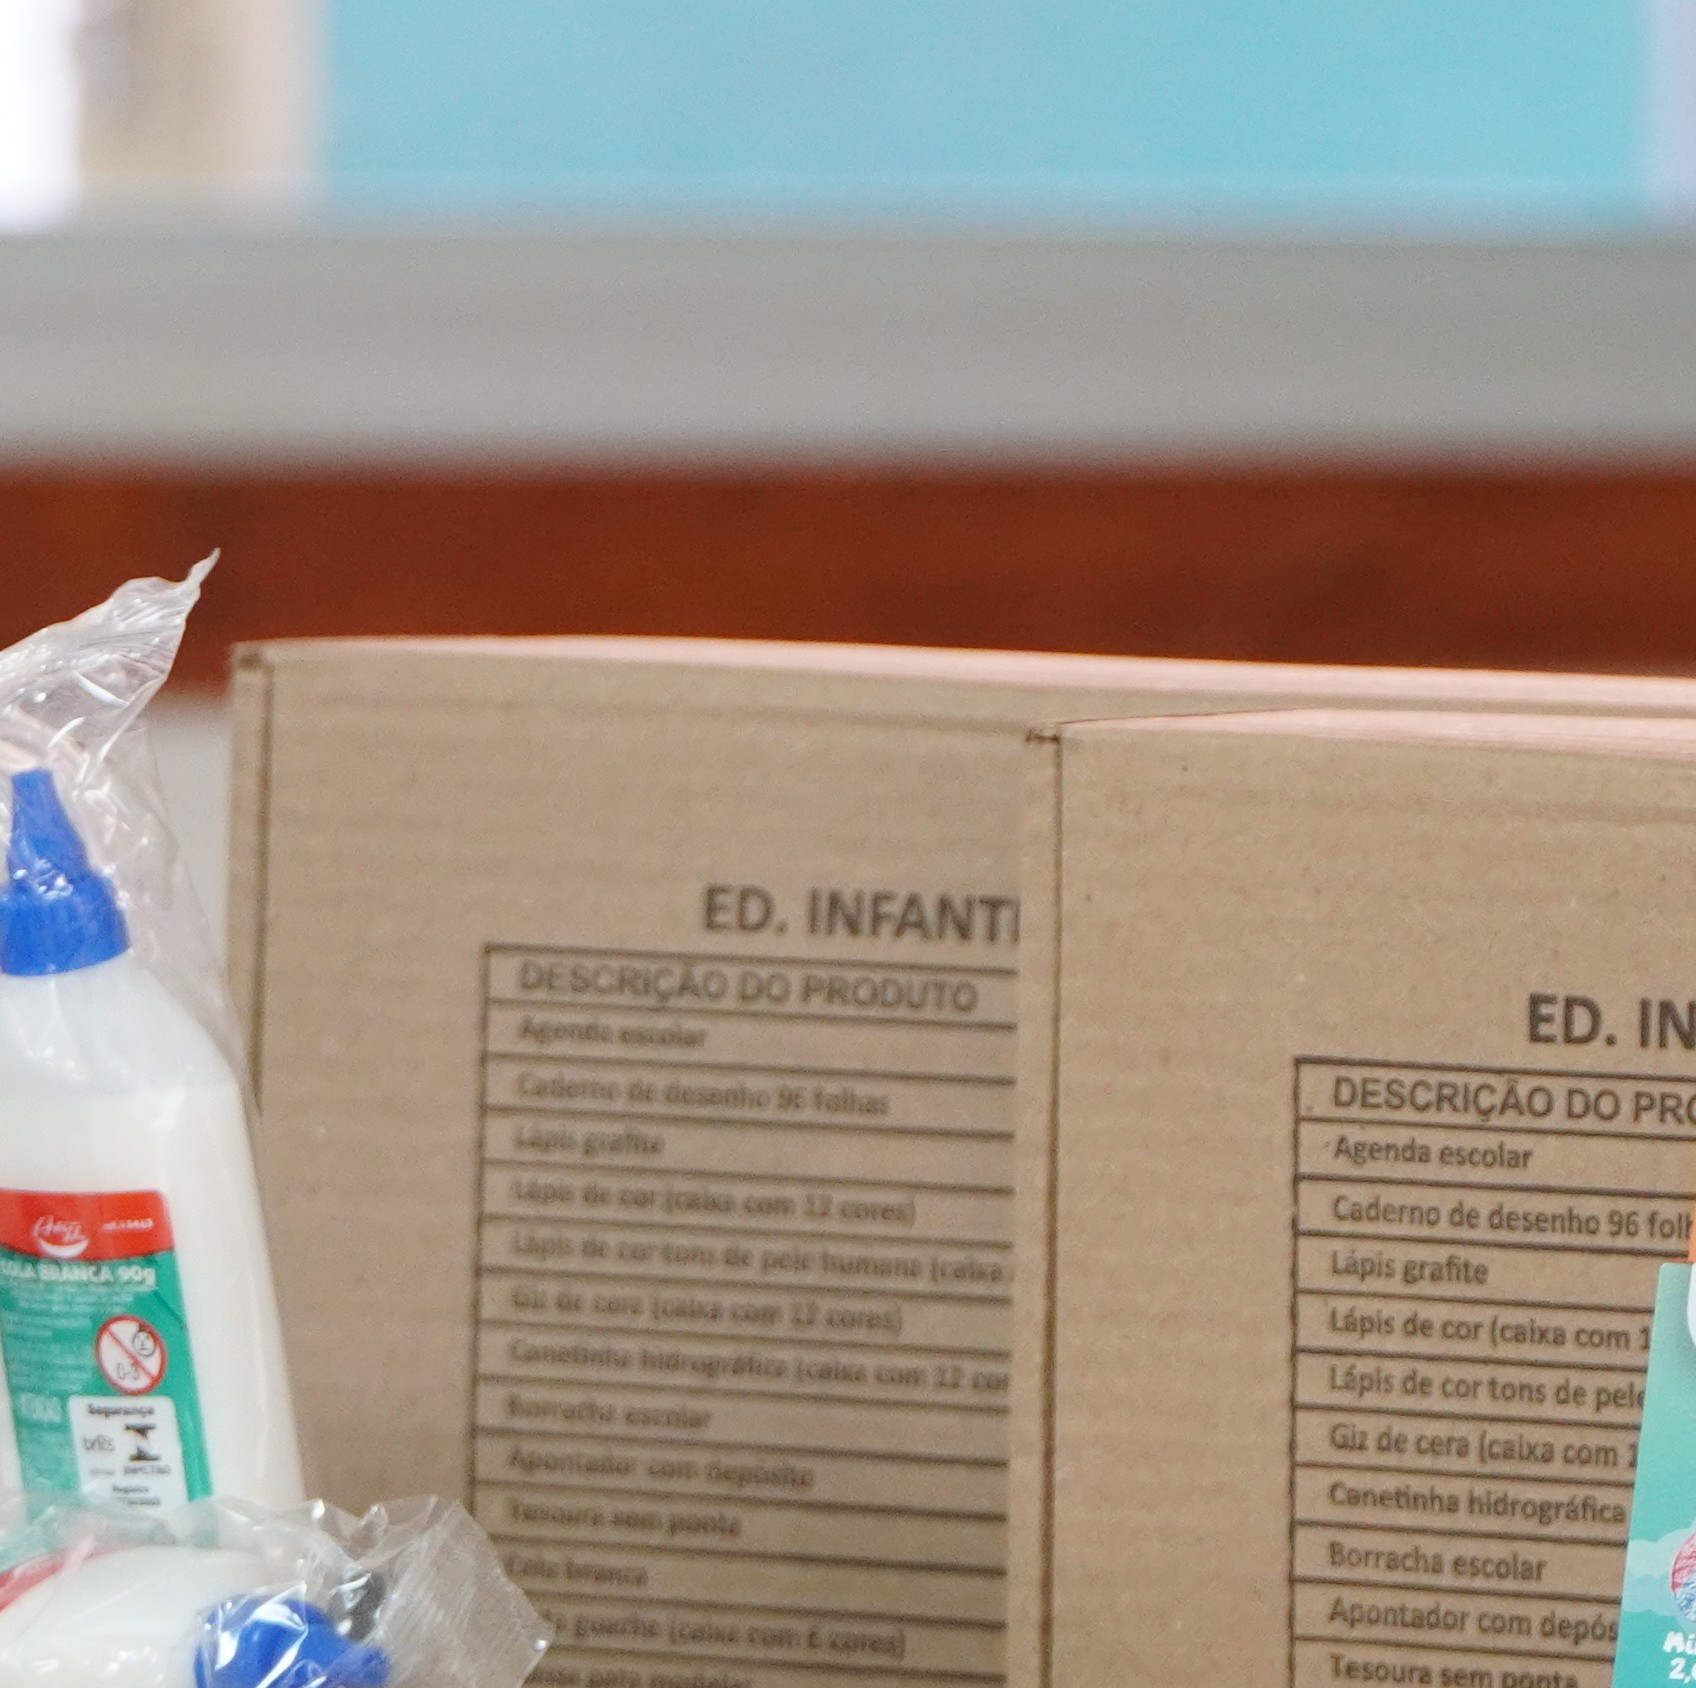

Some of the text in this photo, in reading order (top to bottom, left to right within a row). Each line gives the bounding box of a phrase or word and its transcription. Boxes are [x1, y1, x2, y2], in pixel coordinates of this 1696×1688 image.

[703, 883, 788, 937] ED.
[519, 958, 980, 1015] DESCRIÇÃO DO PRODUTO
[1526, 992, 1616, 1047] ED.
[1331, 1073, 1623, 1124] DESCRIÇÃO DO
[1332, 1135, 1533, 1172] Agenda escolar
[1330, 1194, 1640, 1239] Caderno de desenho 96
[1329, 1251, 1489, 1296] Lápis grafite
[1329, 1306, 1631, 1351] Lápis de cor (caixa com
[1329, 1363, 1588, 1407] Lápis de cor tons de
[1329, 1421, 1619, 1468] Giz de cera (caixa com
[1328, 1481, 1627, 1526] Canetinha hidrográfica
[1329, 1541, 1547, 1586] Borracha escolar
[1328, 1596, 1533, 1637] Apontador com
[1328, 1653, 1431, 1688] Tesoura
